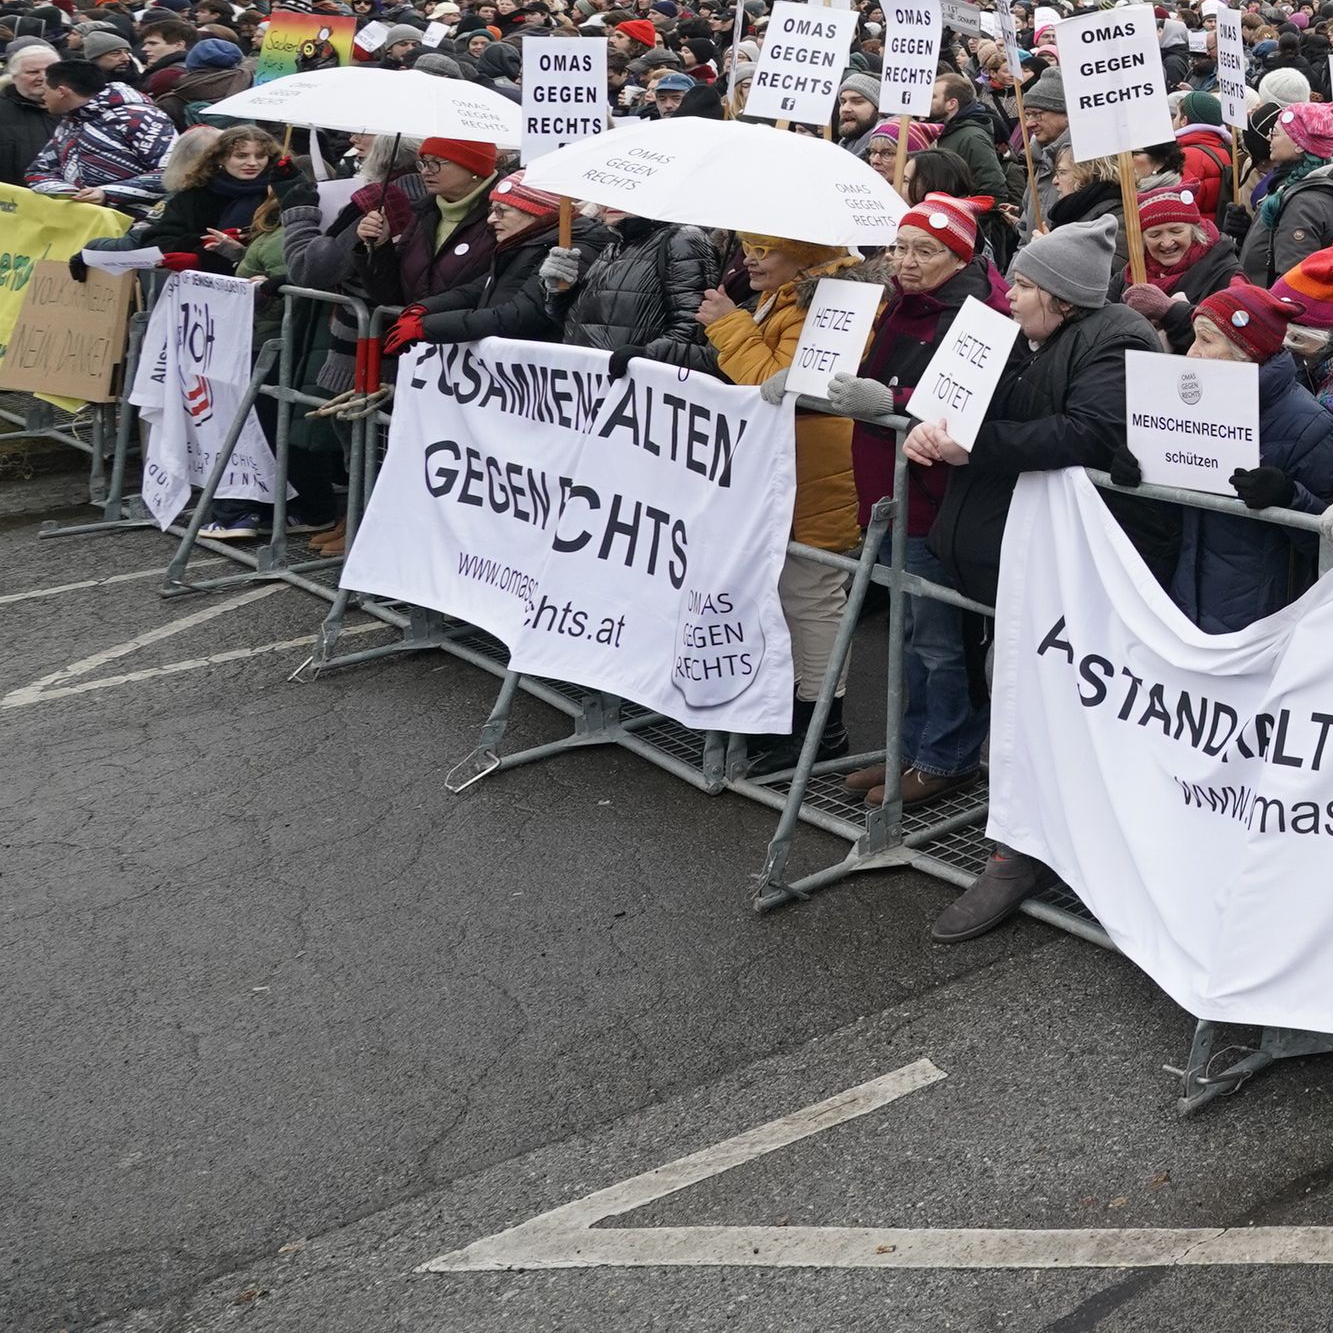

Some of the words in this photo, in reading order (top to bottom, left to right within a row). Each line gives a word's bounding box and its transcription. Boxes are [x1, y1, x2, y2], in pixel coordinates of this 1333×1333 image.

[895, 9, 931, 26] OMAS
[783, 18, 838, 39] OMAS
[1081, 23, 1136, 44] OMAS
[1219, 23, 1237, 42] OMAS
[770, 44, 835, 67] GEGEN
[891, 38, 934, 55] GEGEN
[539, 54, 592, 72] OMAS
[1080, 52, 1145, 76] GEGEN
[1219, 51, 1241, 70] GEGEN
[757, 71, 833, 95] RECHTS
[885, 66, 933, 85] RECHTS
[533, 86, 597, 104] GEGEN
[1079, 83, 1154, 109] RECHTS
[1220, 78, 1245, 100] RECHTS
[451, 99, 491, 112] OMAS
[457, 109, 501, 121] GEGEN
[461, 119, 510, 133] RECHTS
[527, 117, 602, 135] RECHTS
[628, 147, 675, 165] OMAS
[606, 157, 658, 177] GEGEN
[582, 169, 643, 191] RECHTS
[835, 183, 871, 195] OMAS
[845, 198, 885, 211] GEGEN
[852, 214, 897, 227] RECHTS
[812, 307, 855, 332] HETZE
[798, 343, 840, 373] TÖTET
[952, 330, 992, 369] HETZE
[932, 372, 973, 413] TÖTET
[1132, 413, 1253, 442] MENSCHENRECHTE
[1165, 451, 1219, 469] schützen
[425, 440, 551, 530] GEGEN
[552, 476, 688, 590] CHTS
[688, 589, 734, 615] OMAS
[683, 621, 744, 649] GEGEN
[675, 653, 753, 681] RECHTS
